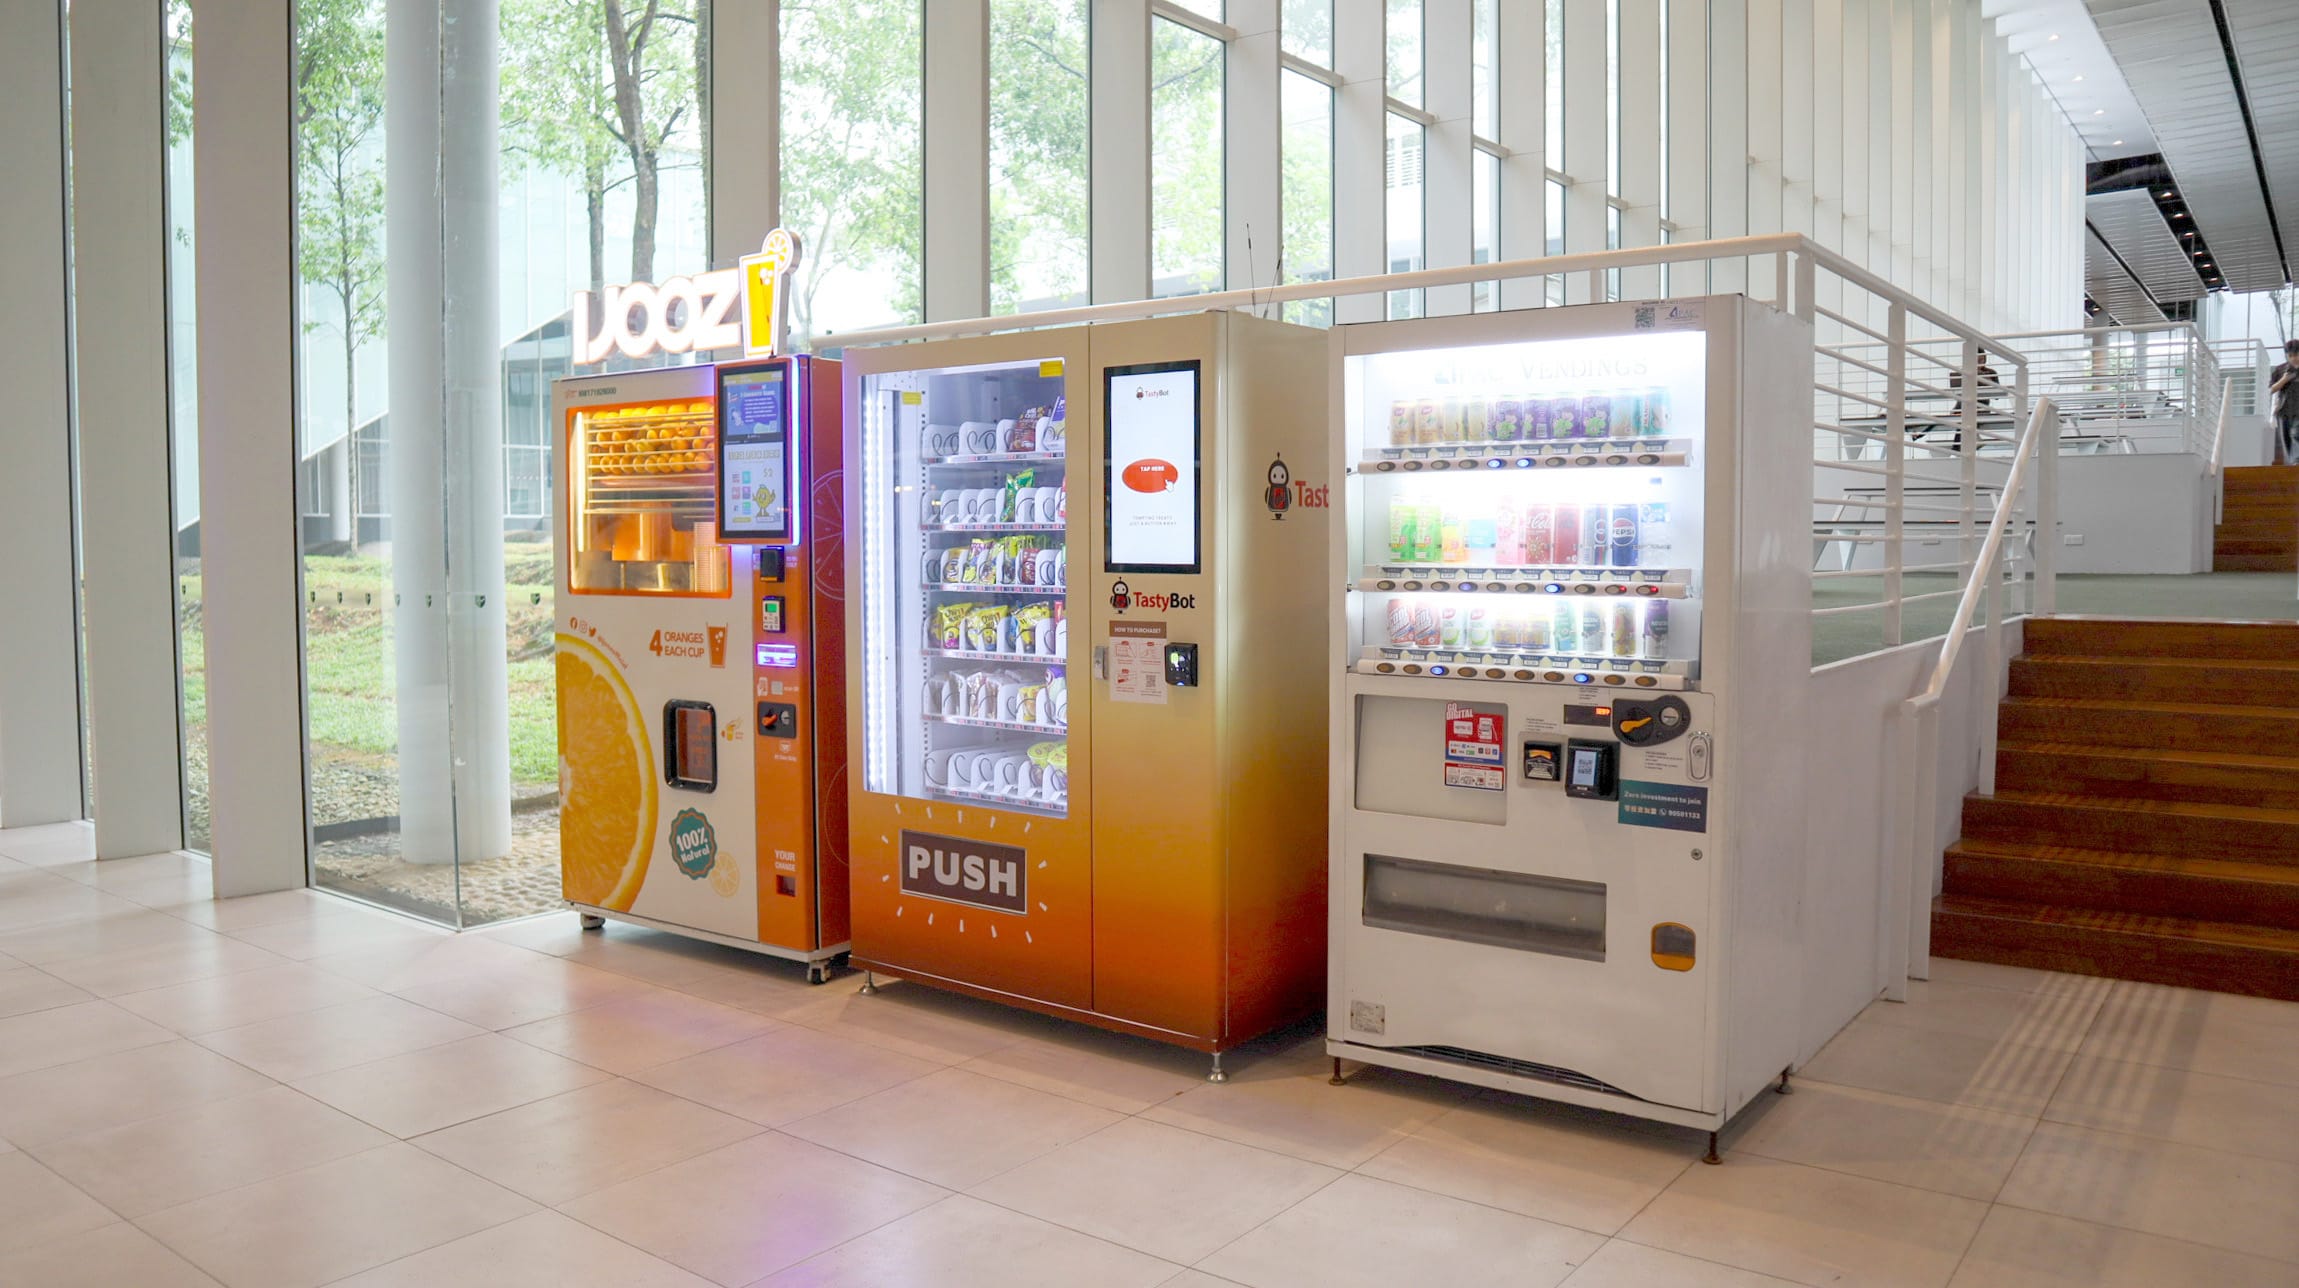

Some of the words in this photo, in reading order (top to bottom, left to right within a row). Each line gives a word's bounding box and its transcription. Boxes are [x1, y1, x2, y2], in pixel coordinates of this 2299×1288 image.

[1520, 356, 1648, 382] VENDINGS
[1145, 389, 1169, 399] TastyBot
[1133, 591, 1195, 612] TastyBot
[649, 629, 663, 657] 4
[664, 631, 704, 644] ORANGES
[664, 645, 687, 657] EACH
[687, 646, 705, 658] CUP
[1447, 702, 1457, 711] GO
[1446, 708, 1474, 720] DIGITAL
[1624, 790, 1639, 799] Zero
[1640, 792, 1679, 804] investment
[676, 827, 708, 852] 100%
[680, 845, 711, 864] Natural
[774, 849, 796, 862] YOUR
[774, 862, 796, 872] CHANGE
[908, 844, 1017, 897] PUSH
